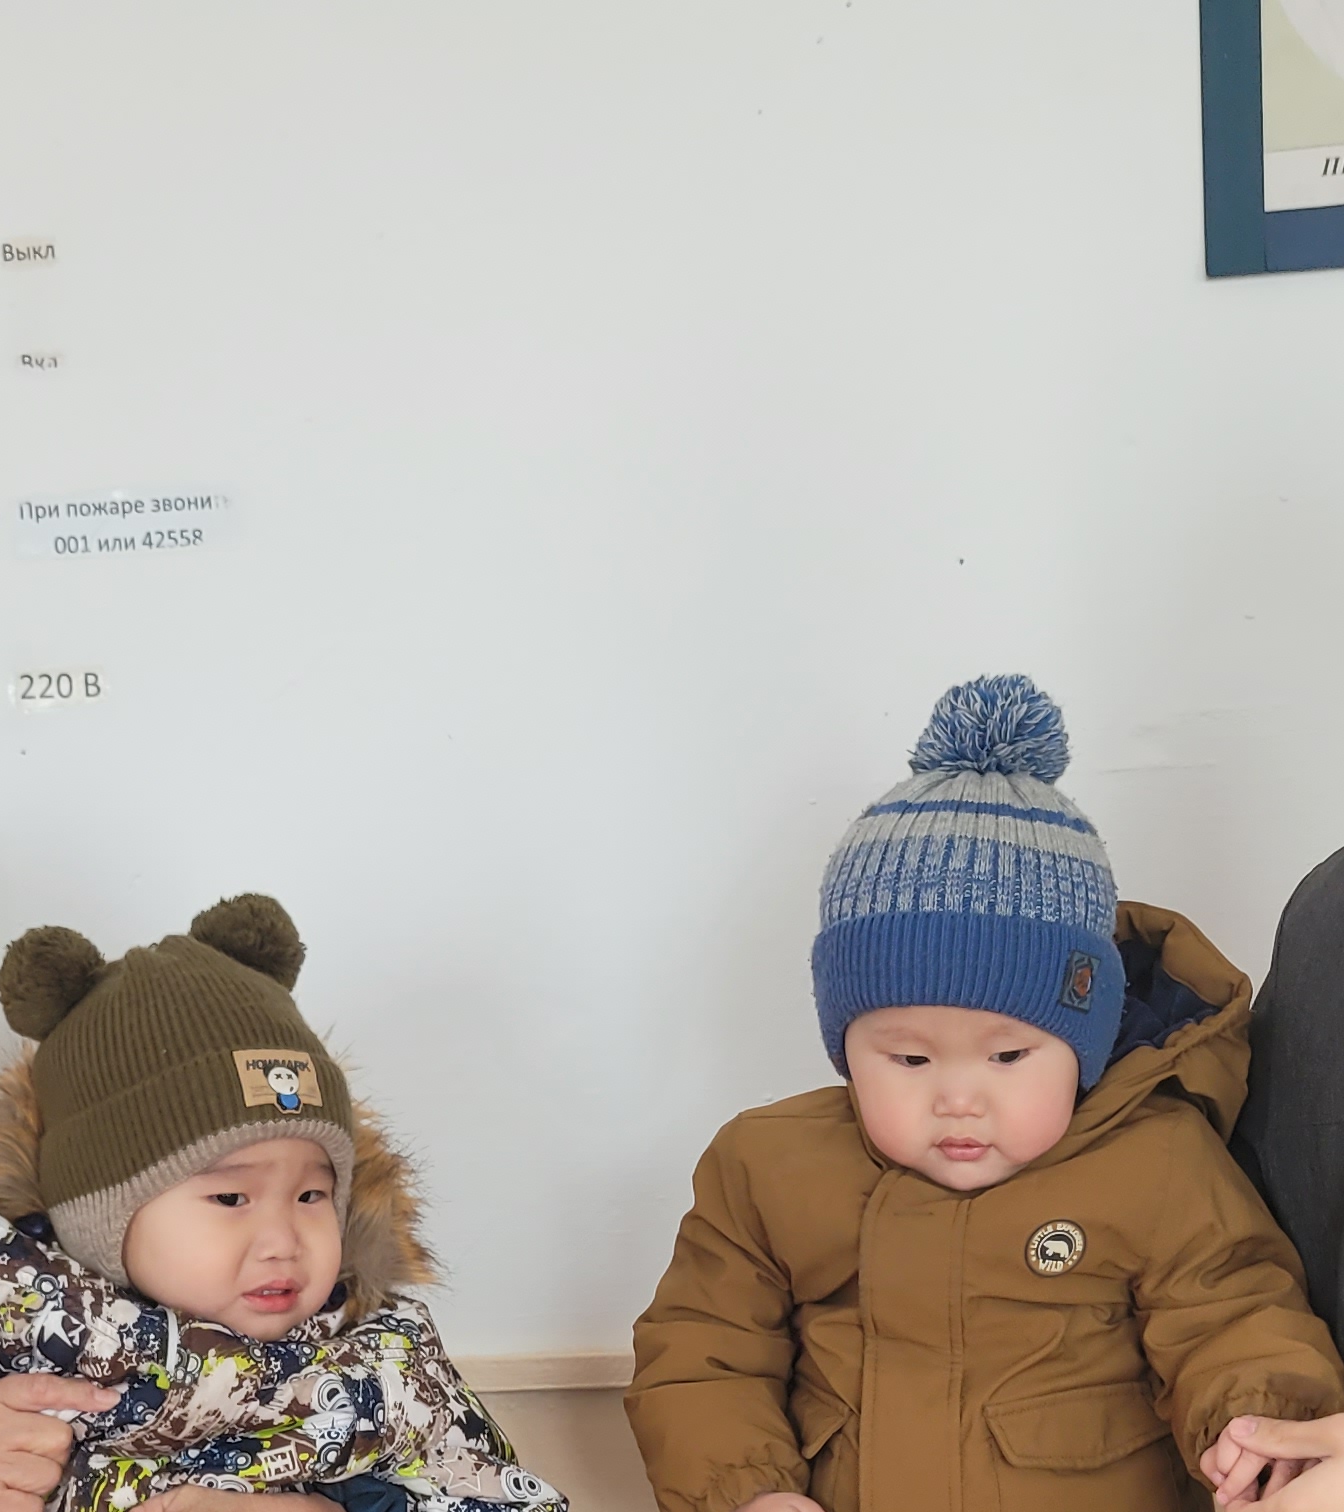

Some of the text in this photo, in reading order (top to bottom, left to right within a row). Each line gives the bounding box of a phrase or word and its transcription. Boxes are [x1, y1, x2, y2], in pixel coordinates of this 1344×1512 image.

[2, 243, 56, 263] Выкл
[19, 502, 60, 524] При
[67, 498, 145, 519] пожаре
[55, 528, 205, 556] 001 или 42558
[20, 672, 101, 700] 220 В
[1039, 1258, 1064, 1272] WILD
